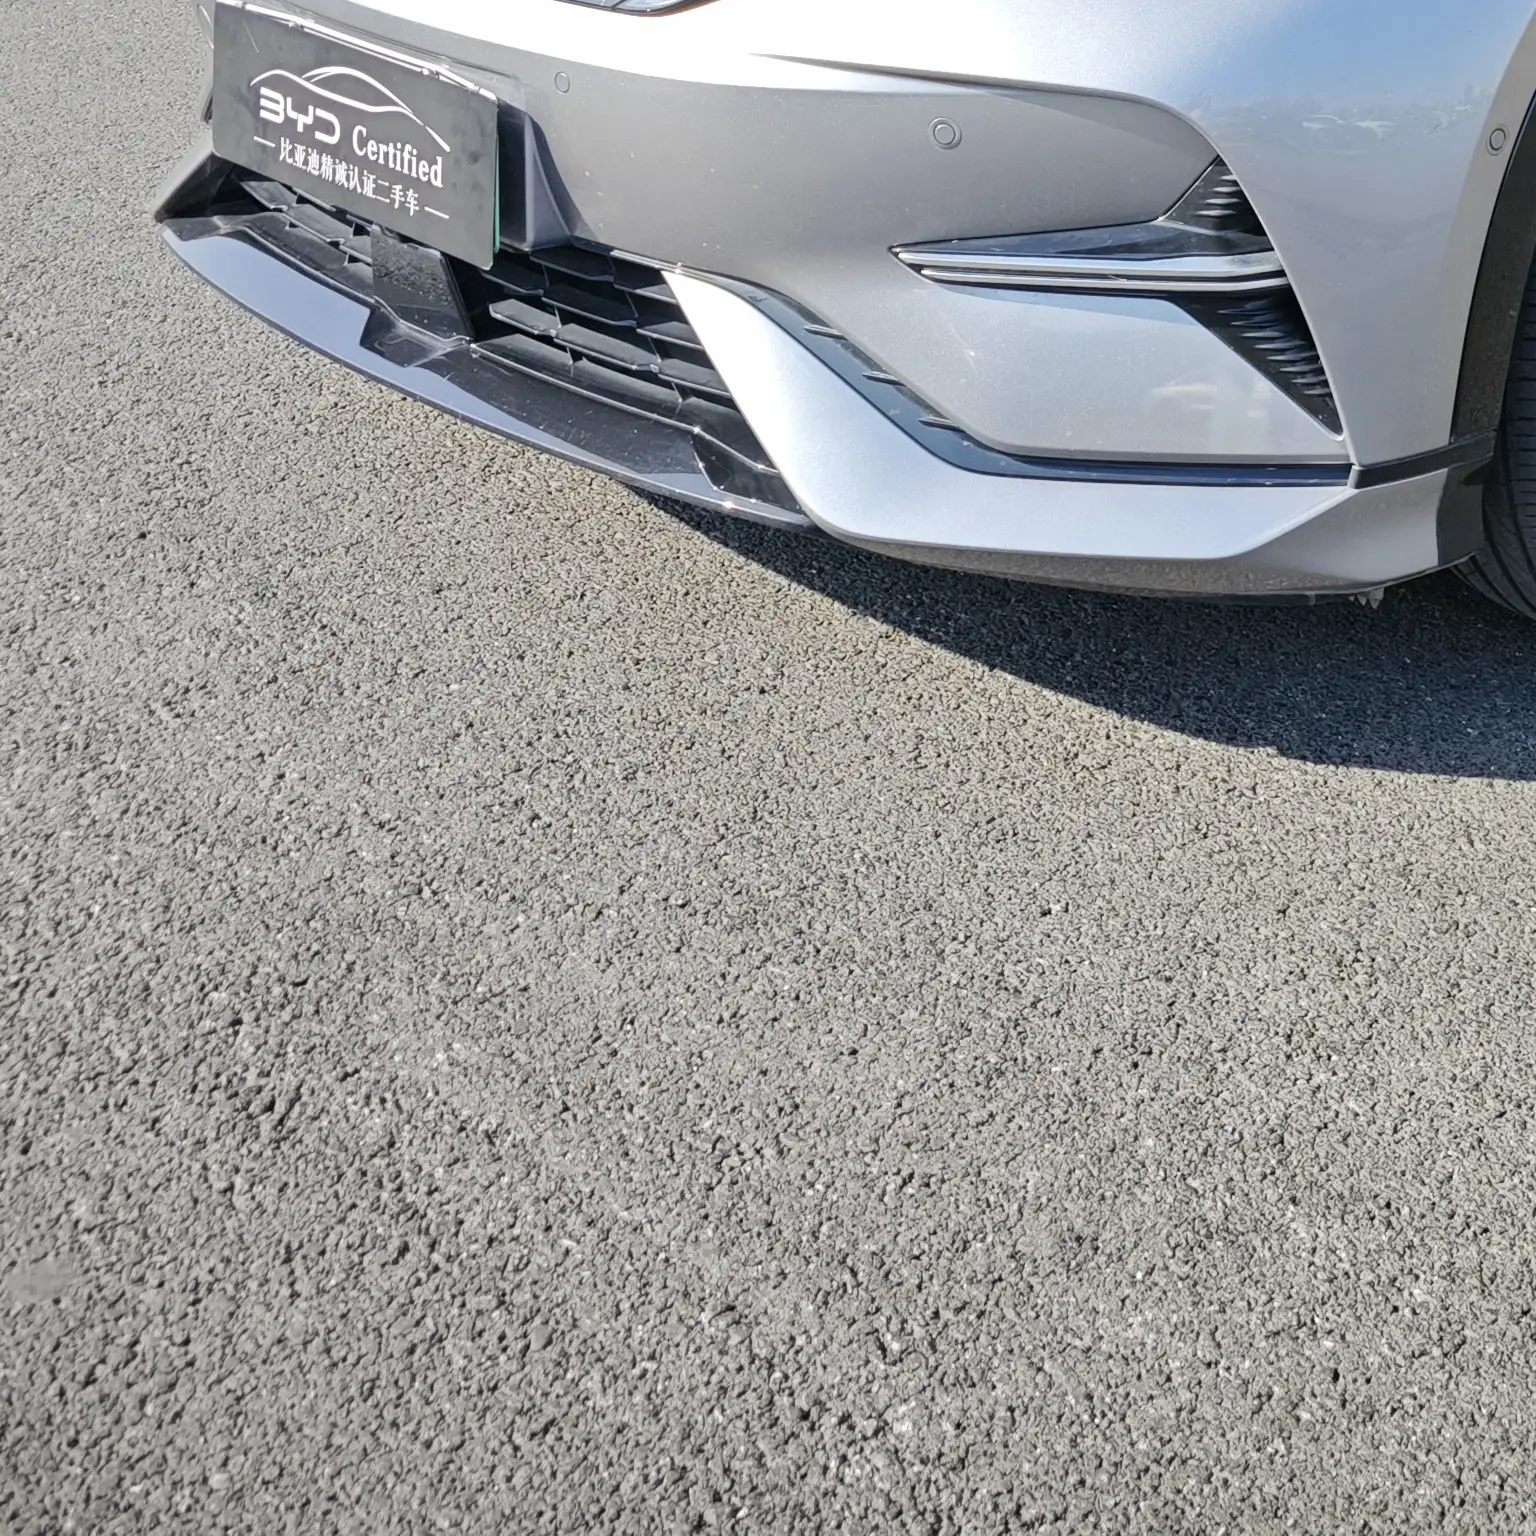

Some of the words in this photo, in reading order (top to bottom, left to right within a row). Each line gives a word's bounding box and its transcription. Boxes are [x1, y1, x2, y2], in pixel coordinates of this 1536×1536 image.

[260, 86, 341, 145] BYD
[352, 125, 444, 188] Certified
[279, 136, 419, 216] 比亚迪精诚认证二手车
